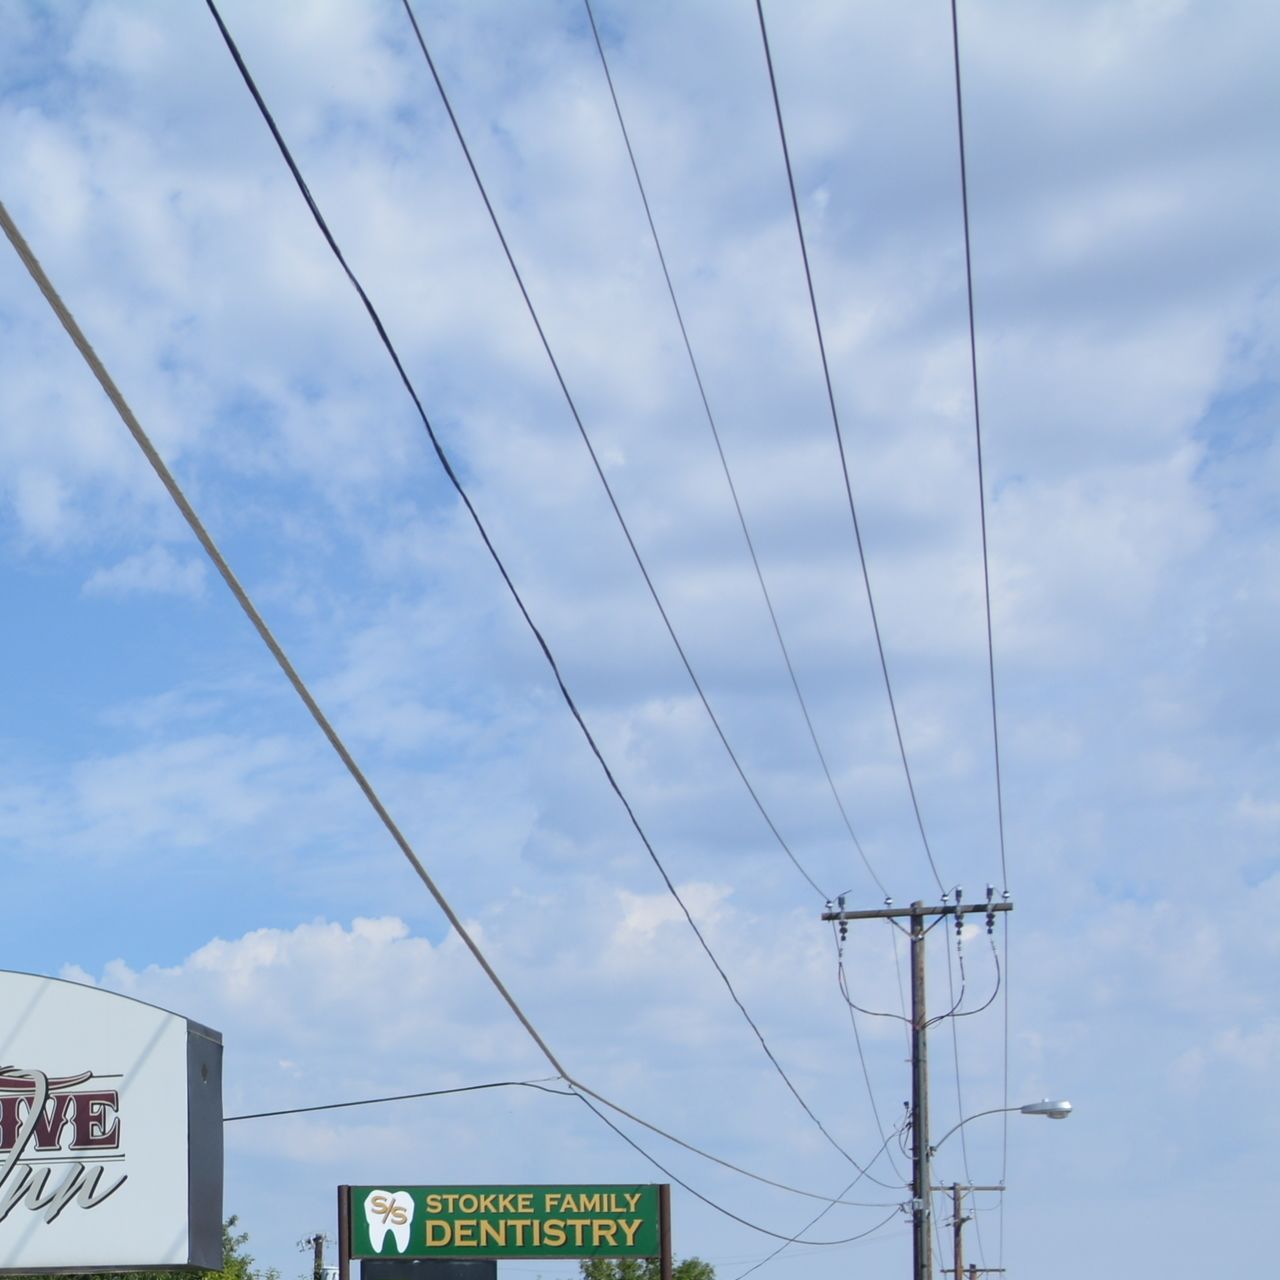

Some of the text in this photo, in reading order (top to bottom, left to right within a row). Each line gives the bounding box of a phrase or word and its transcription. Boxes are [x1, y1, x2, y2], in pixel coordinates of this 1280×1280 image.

[426, 1193, 642, 1213] STOKKE FAMILY
[425, 1219, 643, 1247] DENTISTRY
